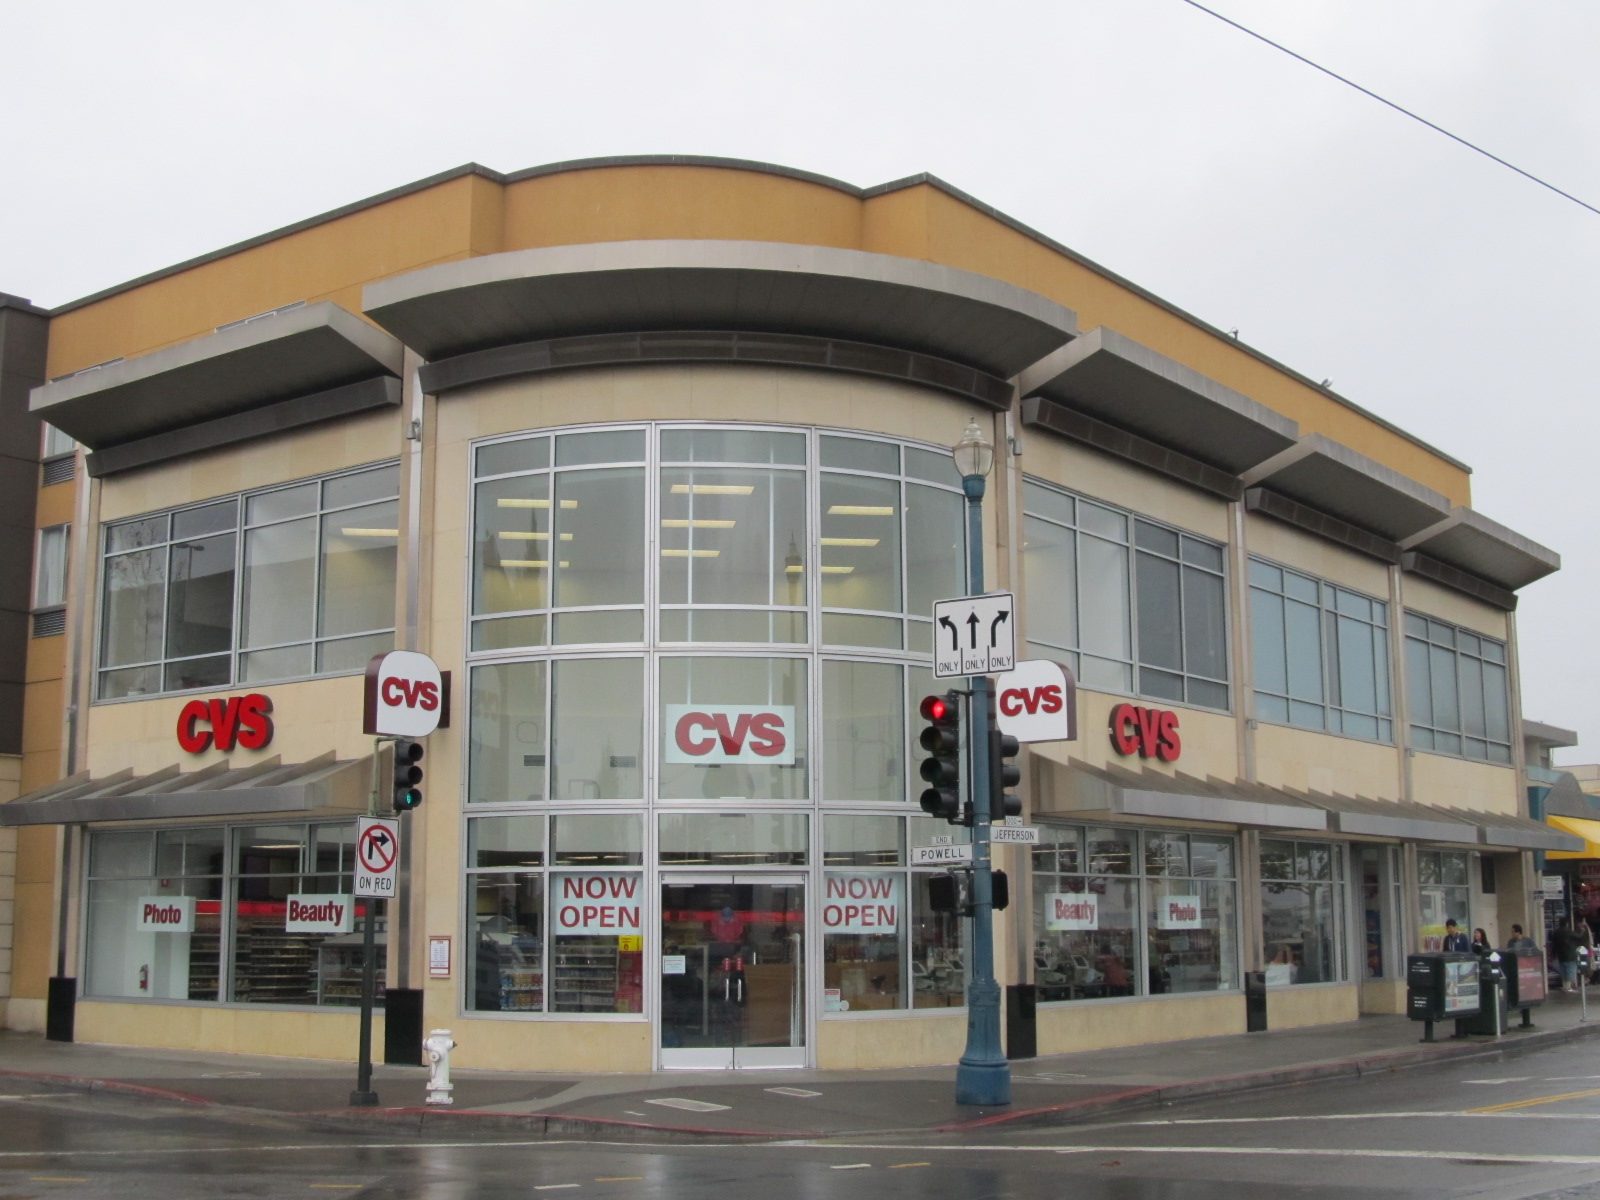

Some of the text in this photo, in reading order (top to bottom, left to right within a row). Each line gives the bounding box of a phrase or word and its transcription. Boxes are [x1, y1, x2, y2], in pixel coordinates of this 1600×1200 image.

[938, 661, 959, 673] ONLY
[965, 659, 985, 669] ONLY
[991, 657, 1011, 667] ONLY
[381, 677, 438, 711] CVS
[999, 684, 1063, 717] CVS
[177, 693, 273, 754] CVS
[674, 711, 786, 757] CVS
[1109, 703, 1181, 762] CVS
[994, 829, 1035, 840] JEFFERSON
[921, 848, 965, 860] POWELL
[359, 876, 392, 890] ON RED
[563, 876, 637, 899] NOW
[826, 877, 893, 899] NOW
[143, 903, 182, 925] Photo
[288, 899, 344, 927] Beauty
[559, 905, 640, 928] OPEN
[823, 904, 895, 927] OPEN
[1054, 898, 1096, 924] Beauty
[1169, 902, 1197, 921] Photo
